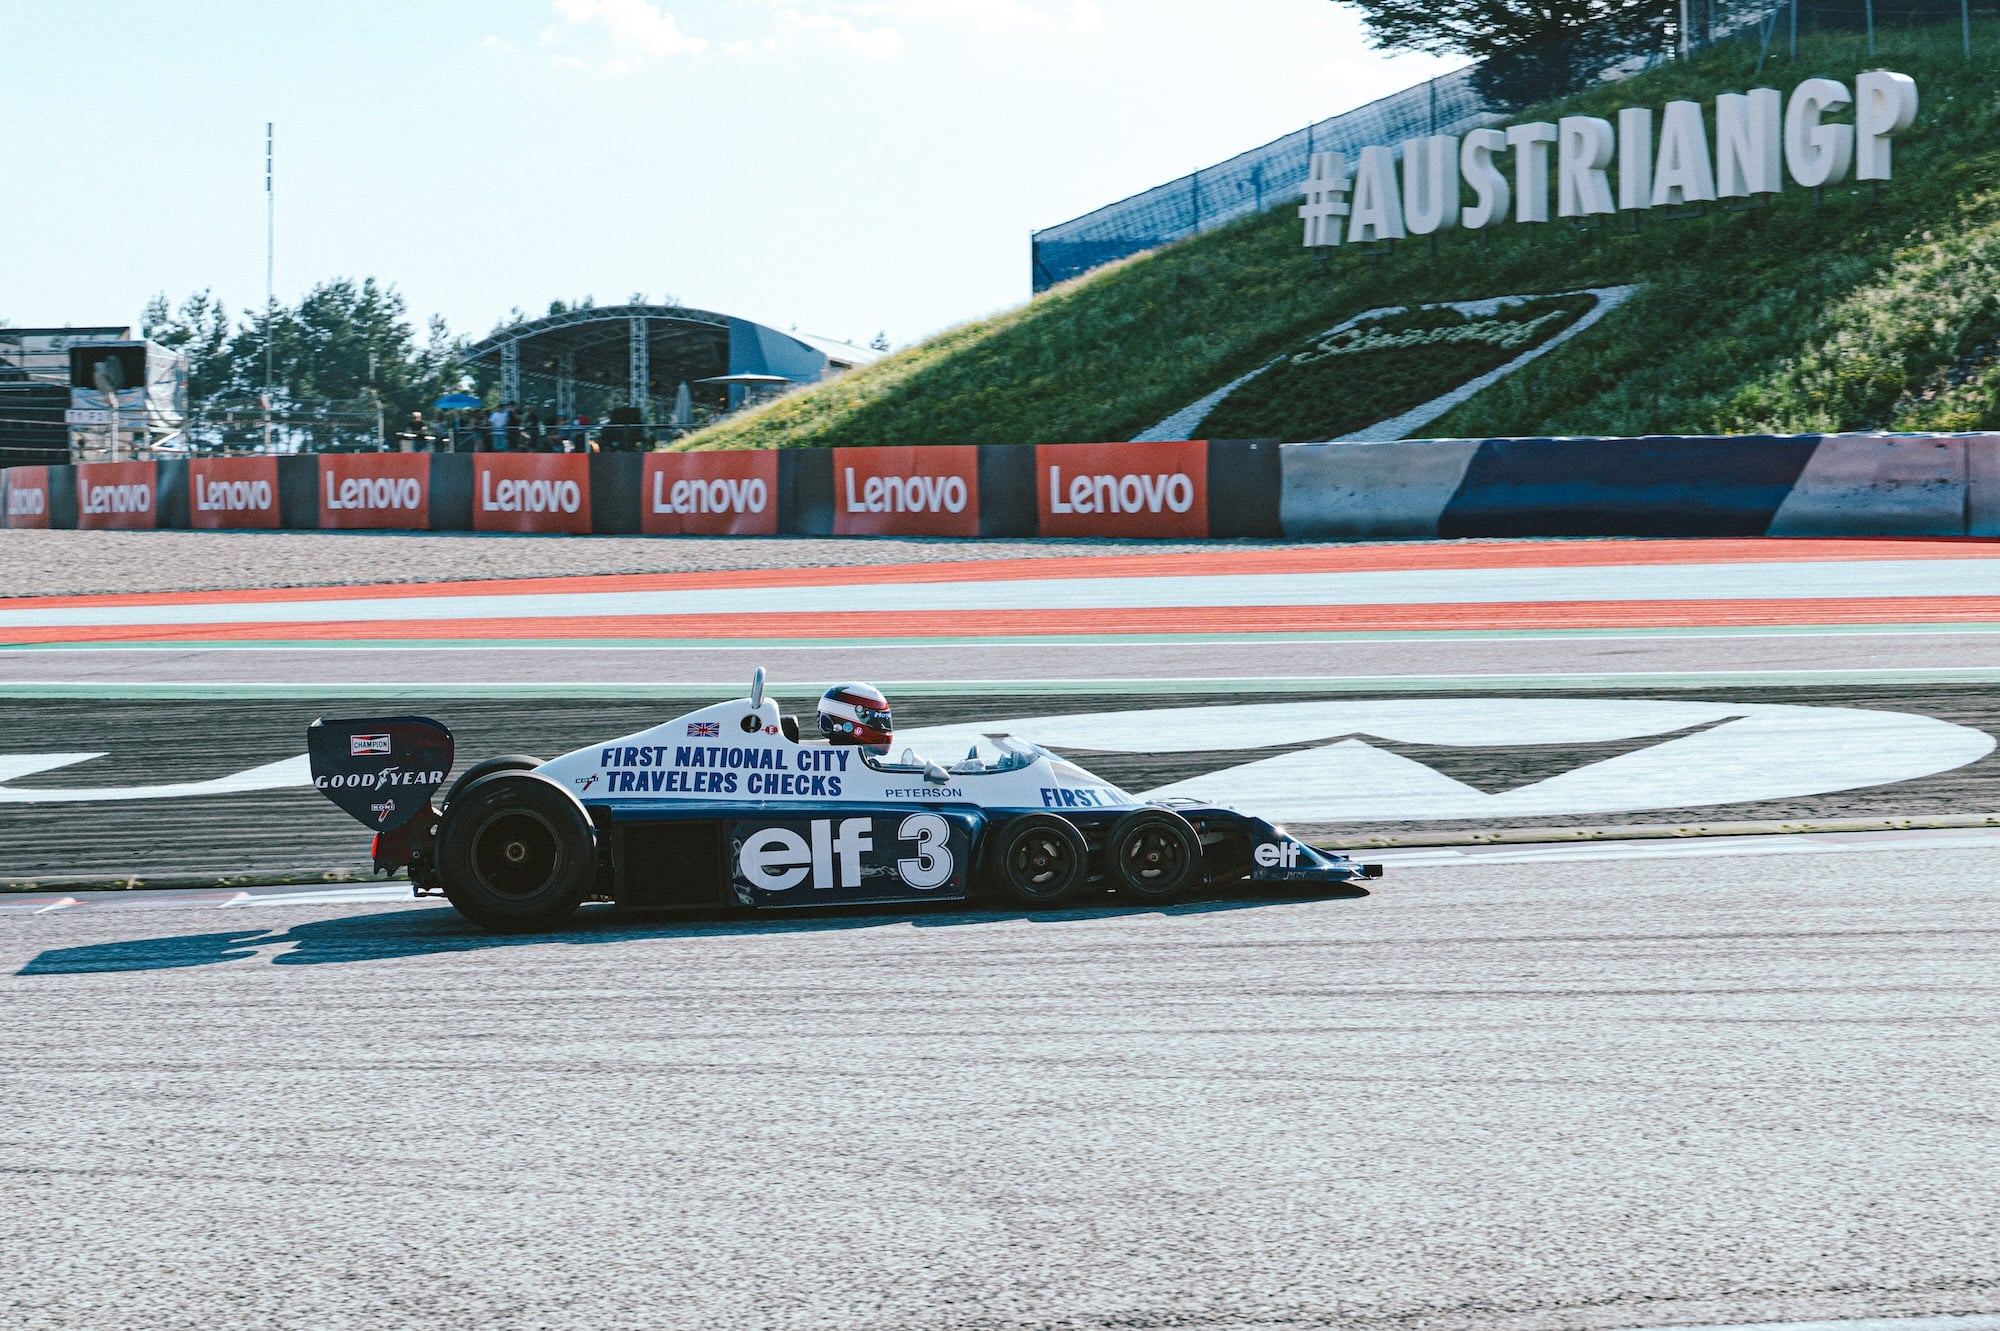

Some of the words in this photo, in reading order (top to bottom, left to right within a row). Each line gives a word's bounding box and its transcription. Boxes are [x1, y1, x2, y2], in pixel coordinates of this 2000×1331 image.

[1298, 70, 1918, 248] #AUSTRIANGP
[81, 479, 150, 514] Lenovo
[195, 474, 272, 511] Lenovo
[326, 470, 421, 510] Lenovo
[482, 470, 580, 513] Lenovo
[653, 471, 767, 514] Lenovo
[845, 467, 968, 514] Lenovo
[1050, 465, 1194, 514] Lenovo
[354, 740, 388, 749] CHAMPION
[601, 746, 668, 768] FIRST
[675, 746, 788, 770] NATIONAL
[797, 750, 850, 772] CITY
[606, 771, 738, 793] TRAVELERS
[747, 772, 842, 797] CHECKS
[885, 788, 962, 798] PETERSON
[1040, 788, 1103, 807] FIRST
[740, 817, 873, 891] elf
[897, 812, 954, 890] 3
[1254, 842, 1301, 868] elf
